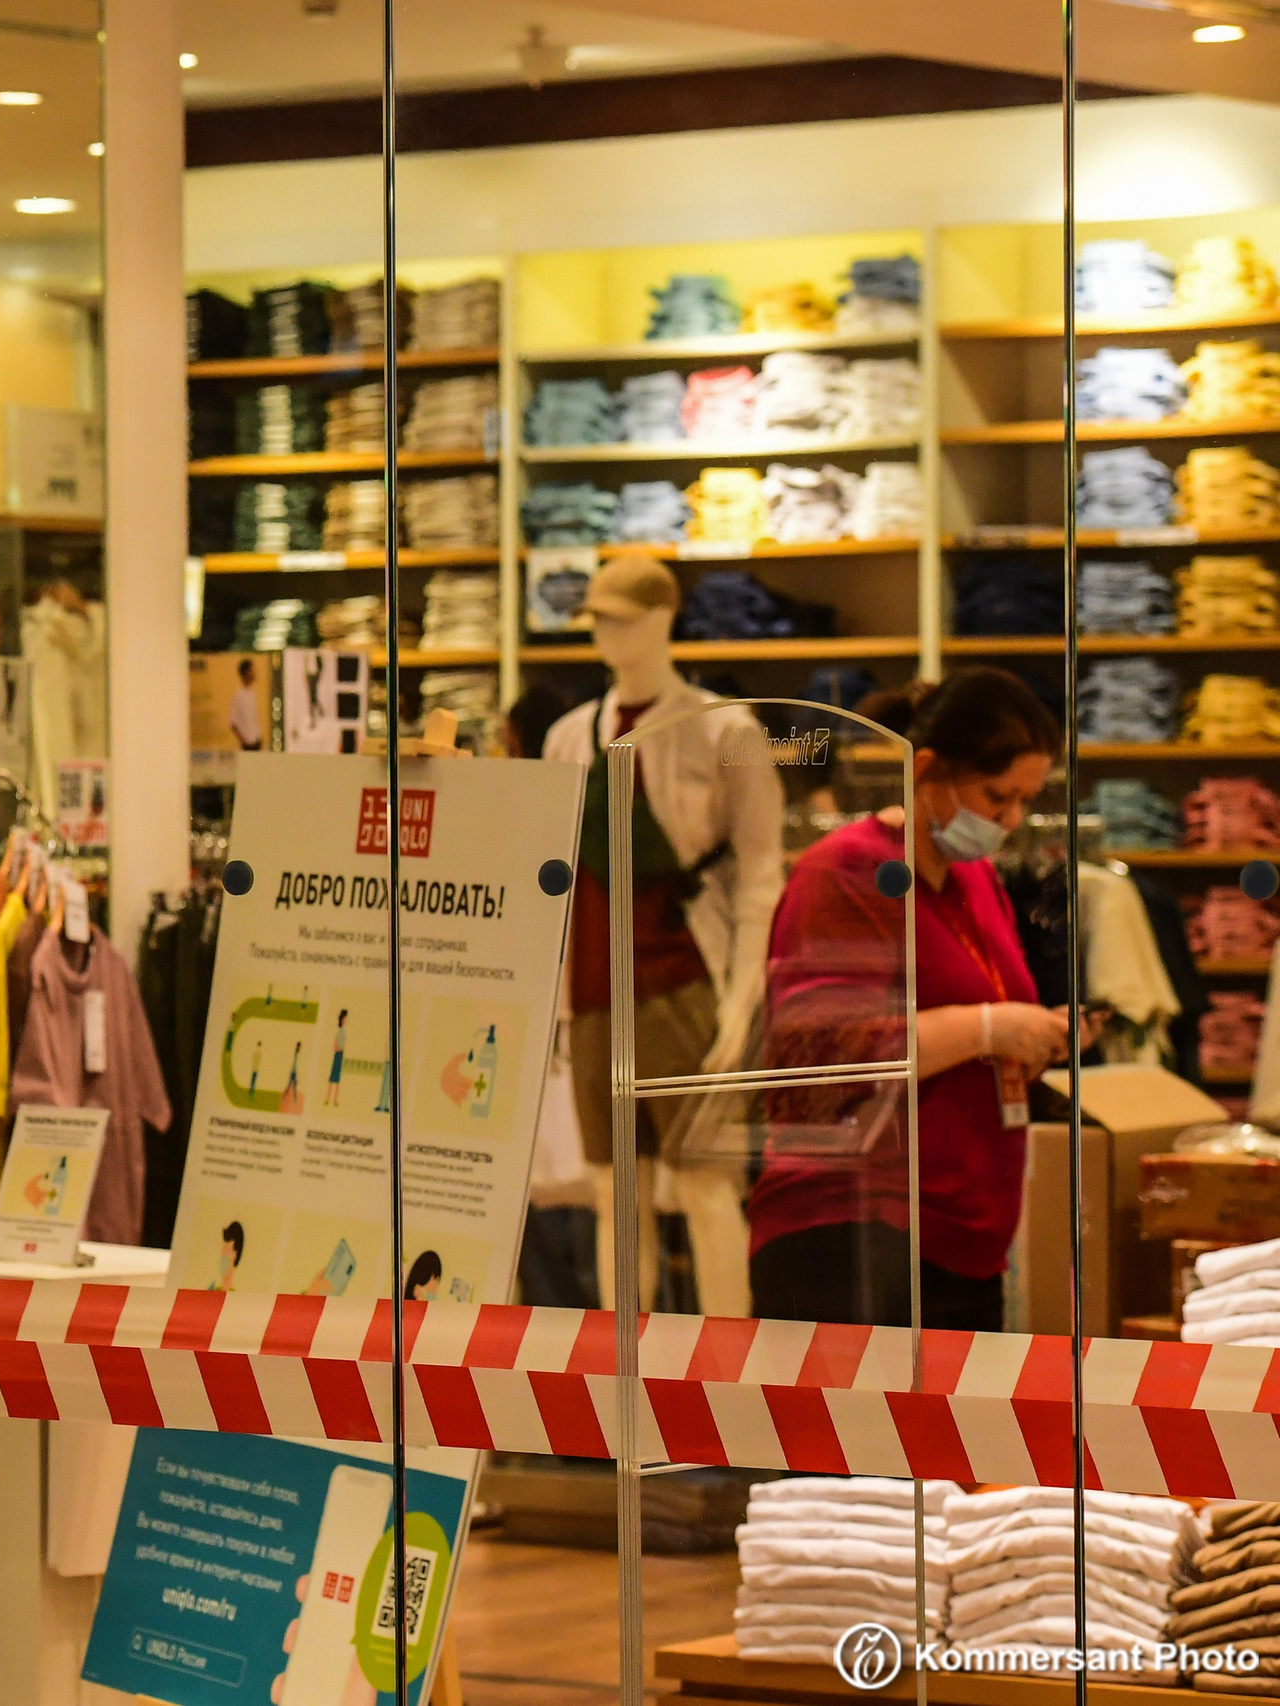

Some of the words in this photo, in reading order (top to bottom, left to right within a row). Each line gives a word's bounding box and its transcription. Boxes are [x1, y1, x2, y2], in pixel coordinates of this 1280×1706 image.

[401, 797, 430, 821] UNI
[399, 824, 429, 853] QLO
[274, 871, 344, 910] ДОБРО
